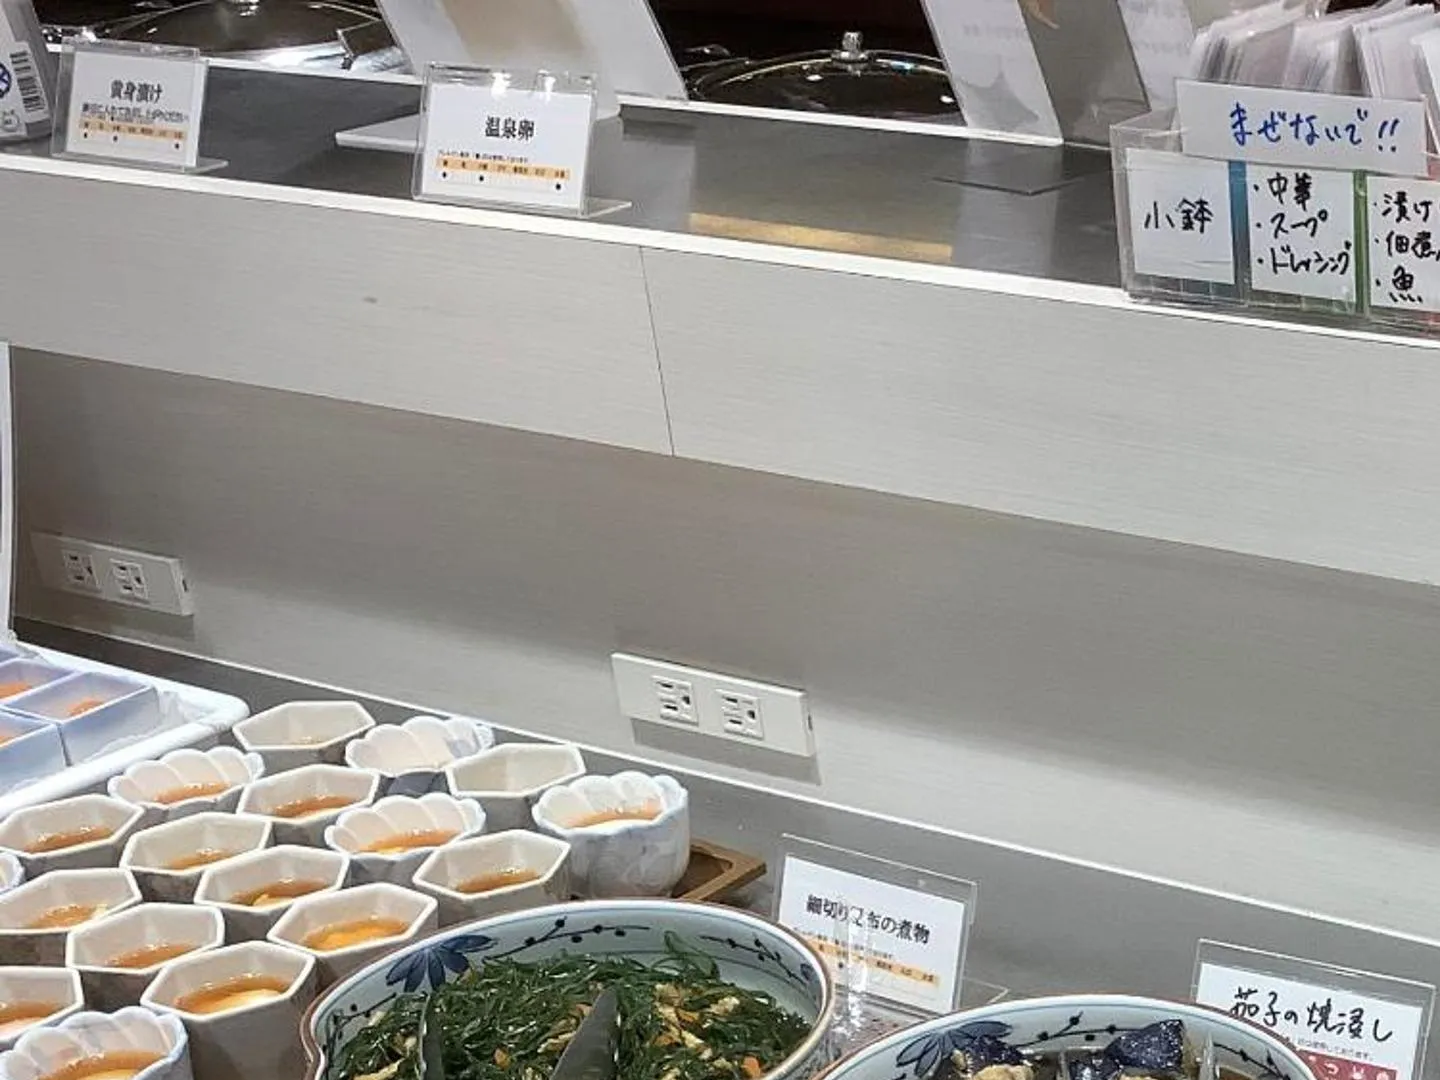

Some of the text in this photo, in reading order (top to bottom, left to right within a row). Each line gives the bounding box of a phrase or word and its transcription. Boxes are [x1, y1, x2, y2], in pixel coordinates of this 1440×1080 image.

[484, 116, 535, 142] 温泉卵
[1144, 196, 1215, 234] 小鉢
